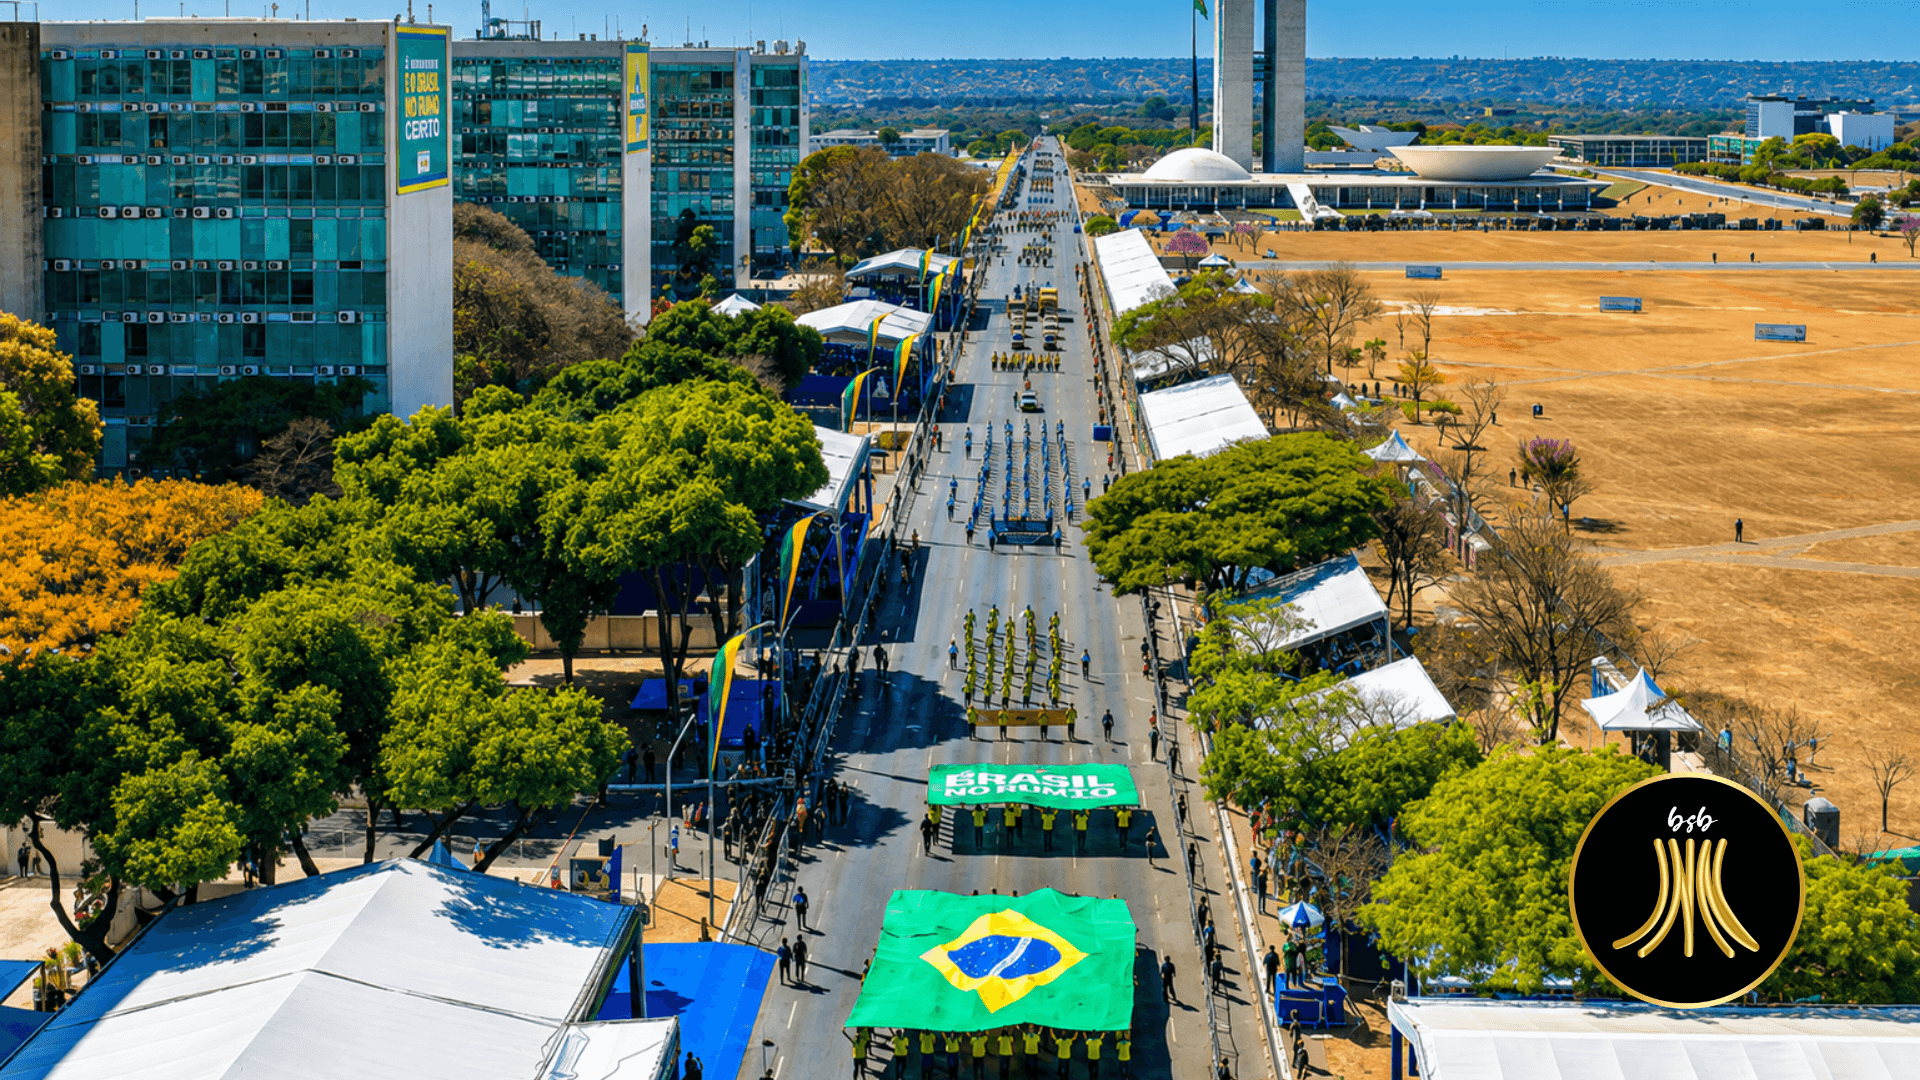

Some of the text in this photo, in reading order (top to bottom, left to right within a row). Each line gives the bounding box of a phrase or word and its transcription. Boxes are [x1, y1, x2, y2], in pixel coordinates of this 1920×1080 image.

[405, 96, 417, 117] NO
[405, 118, 440, 140] CERTO
[945, 770, 1115, 788] BRASIL
[944, 786, 990, 797] NO
